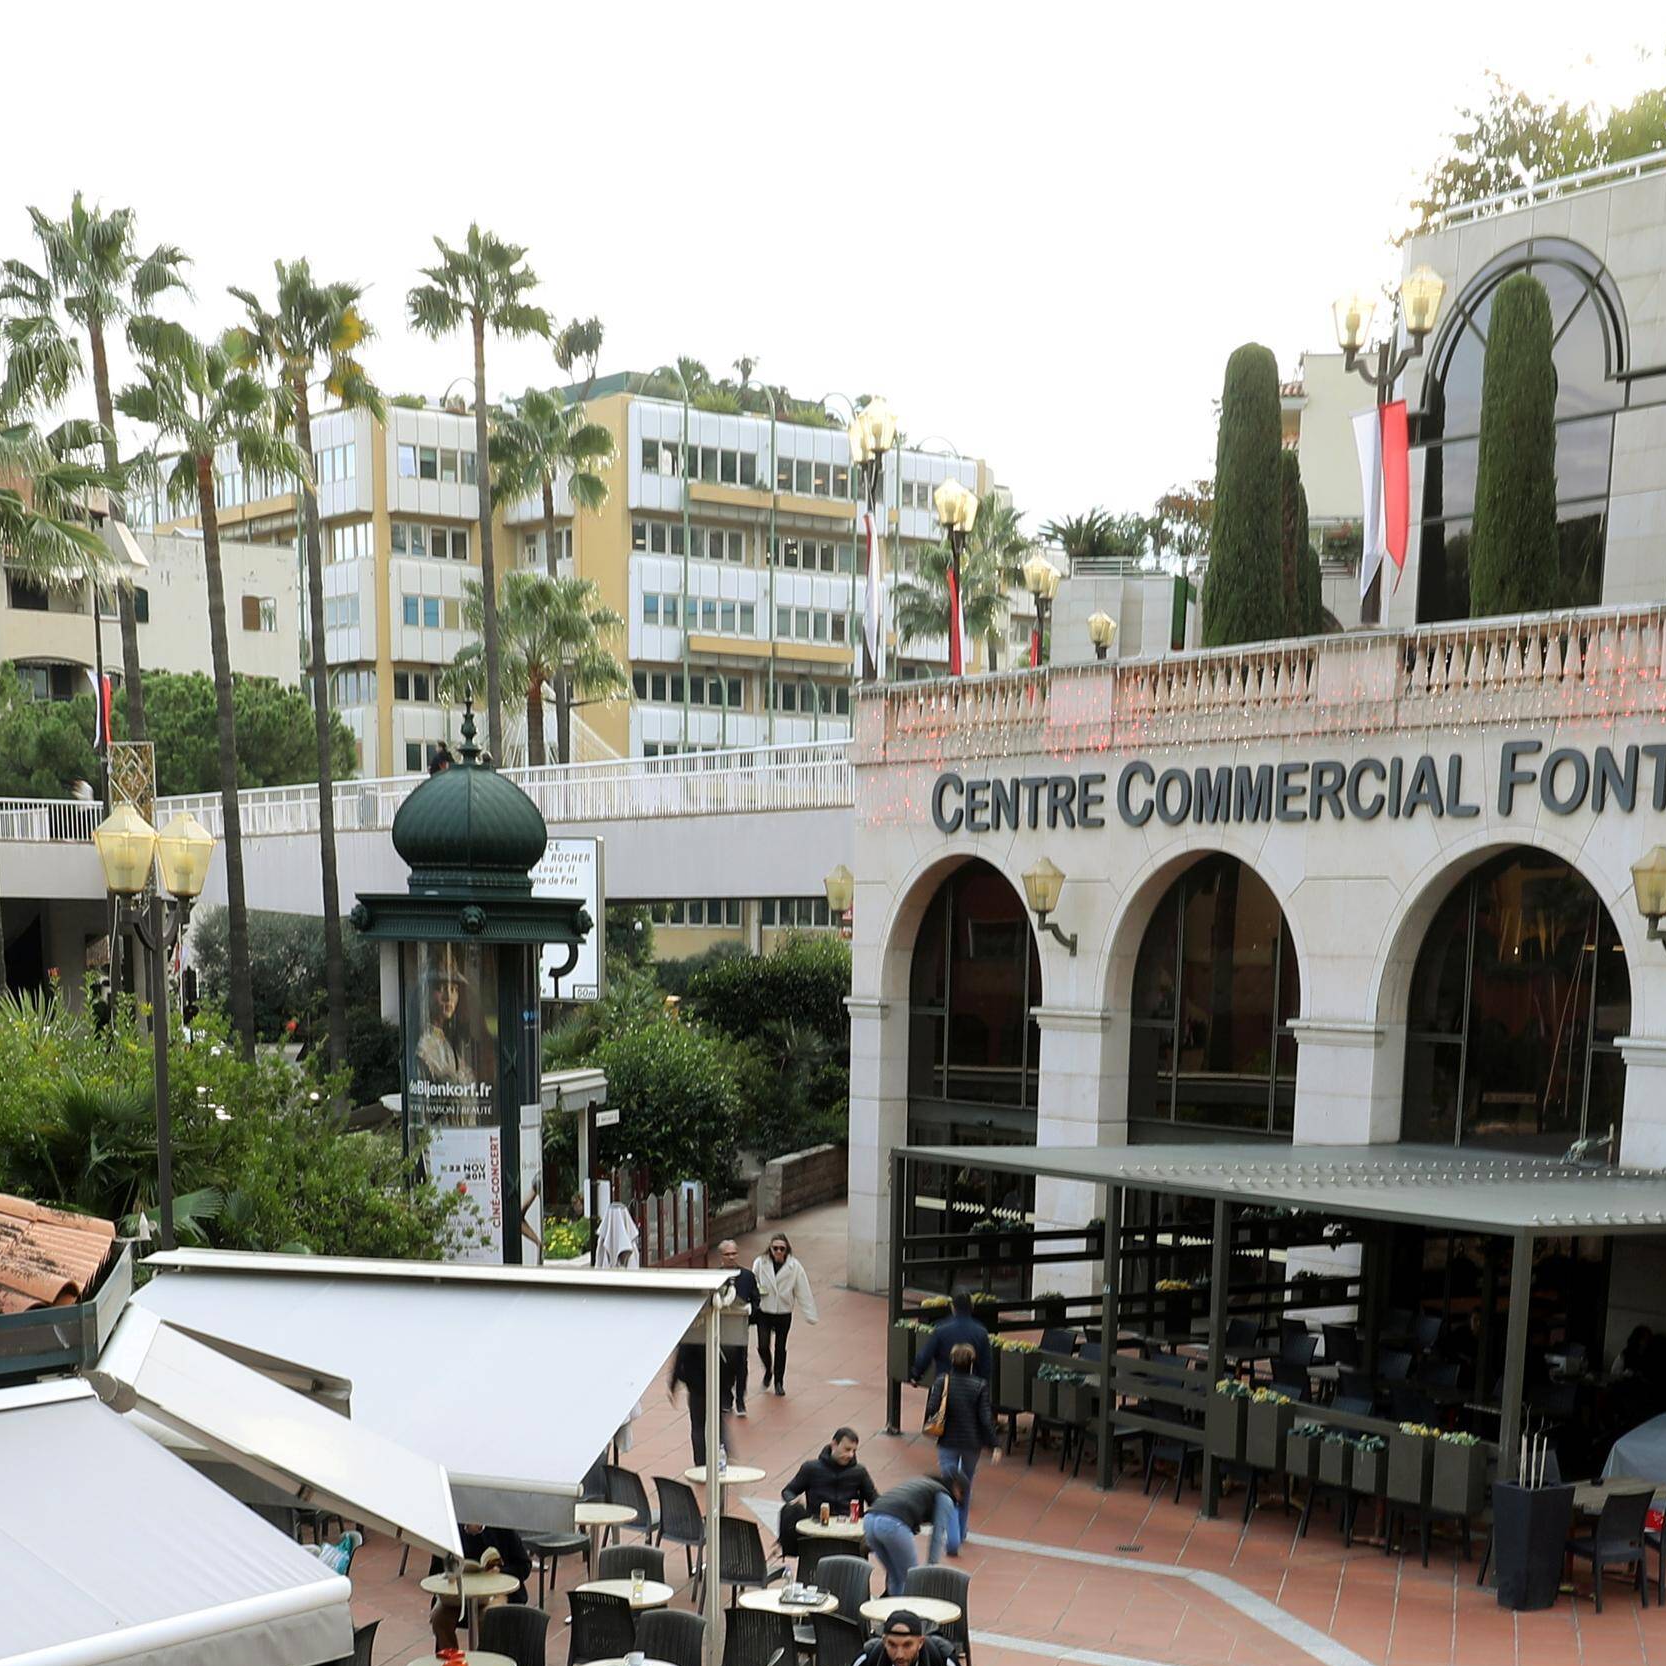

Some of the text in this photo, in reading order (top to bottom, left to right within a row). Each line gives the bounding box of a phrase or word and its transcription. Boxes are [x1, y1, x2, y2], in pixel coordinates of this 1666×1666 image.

[931, 771, 1106, 834] CENTRE
[1118, 754, 1480, 827] COMMERCIAL
[550, 852, 591, 864] ROCHER
[463, 1163, 487, 1173] NOV
